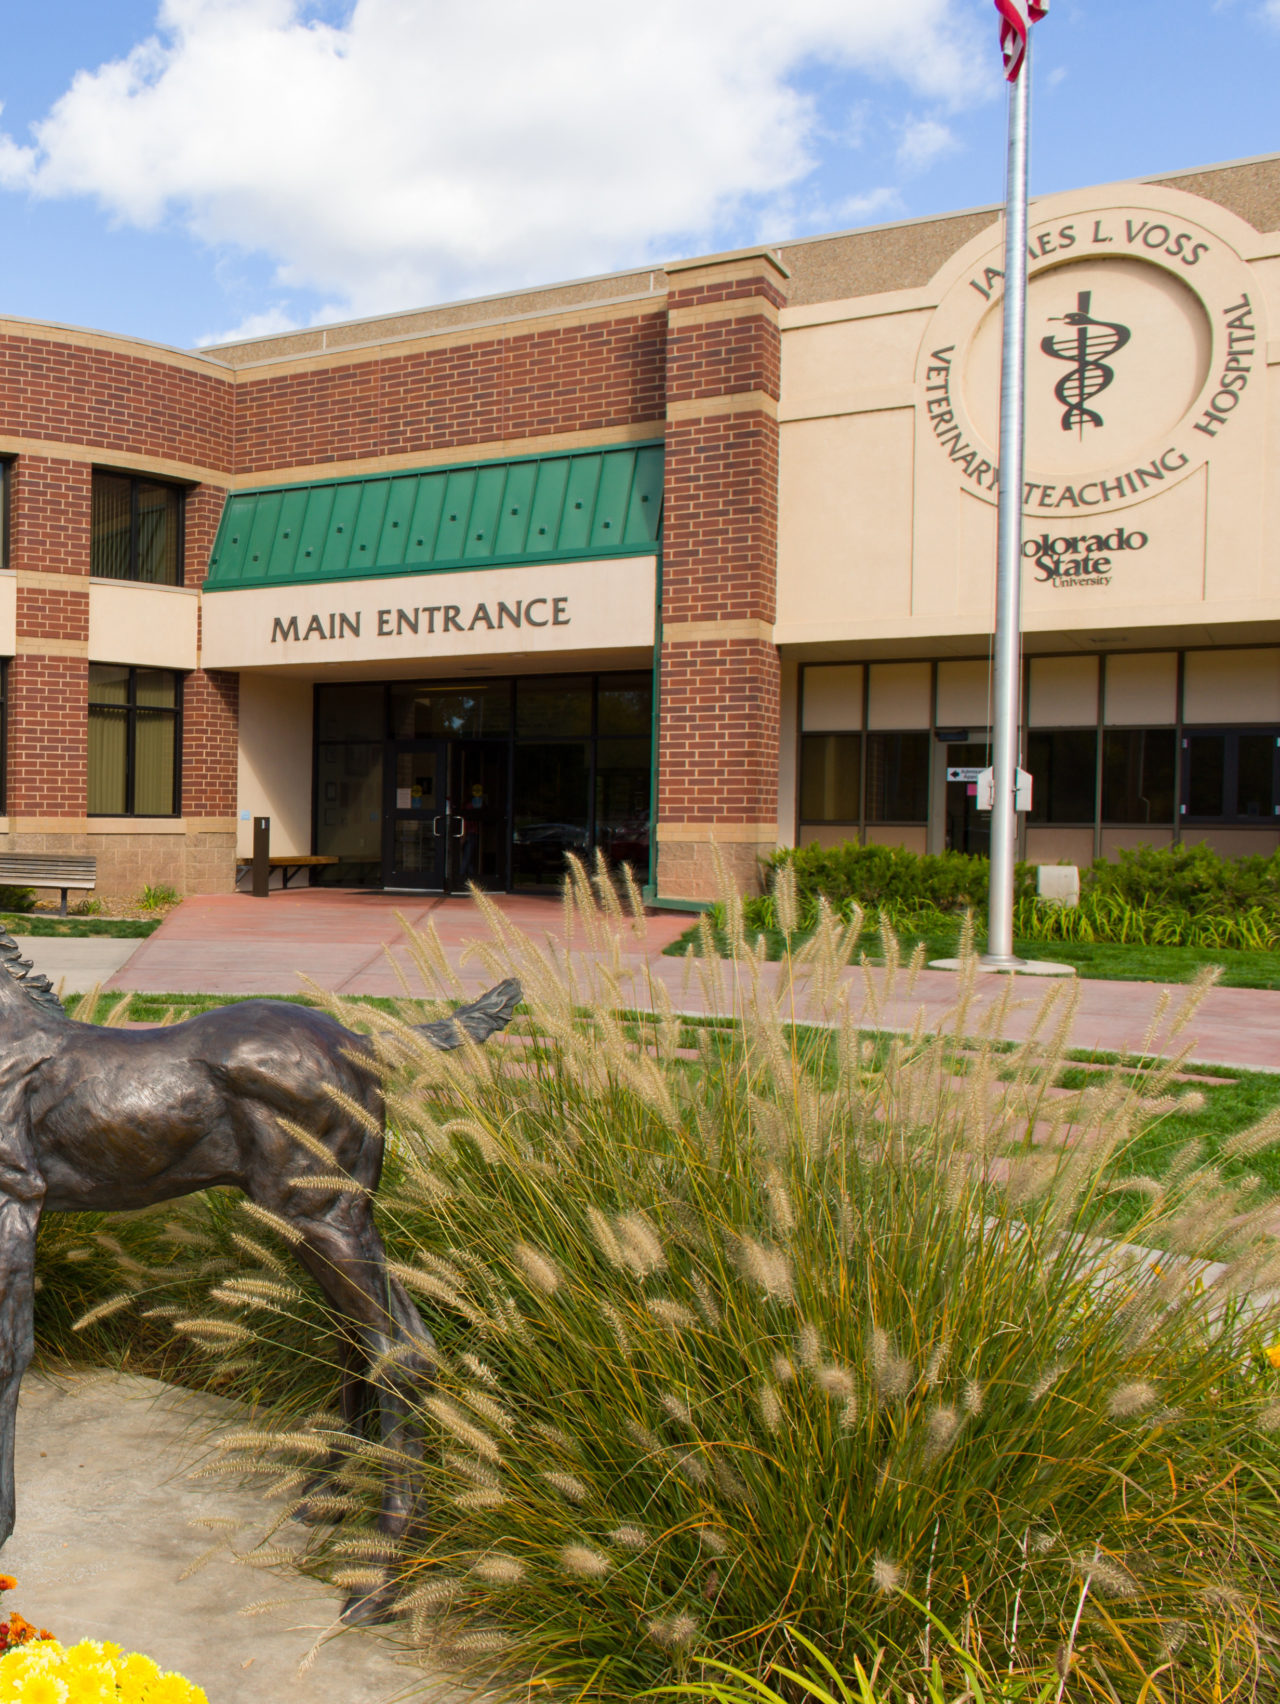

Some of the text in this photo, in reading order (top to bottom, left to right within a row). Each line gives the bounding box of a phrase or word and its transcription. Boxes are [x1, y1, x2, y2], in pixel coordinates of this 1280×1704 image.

[1092, 220, 1113, 243] L.
[1126, 219, 1210, 265] VOSS
[1023, 447, 1189, 508] TEACHING
[1192, 292, 1256, 438] HOSPITAL
[1021, 527, 1149, 558] olorado
[1034, 552, 1112, 582] State
[1052, 575, 1112, 588] University
[270, 596, 571, 643] MAIN ENTRANCE
